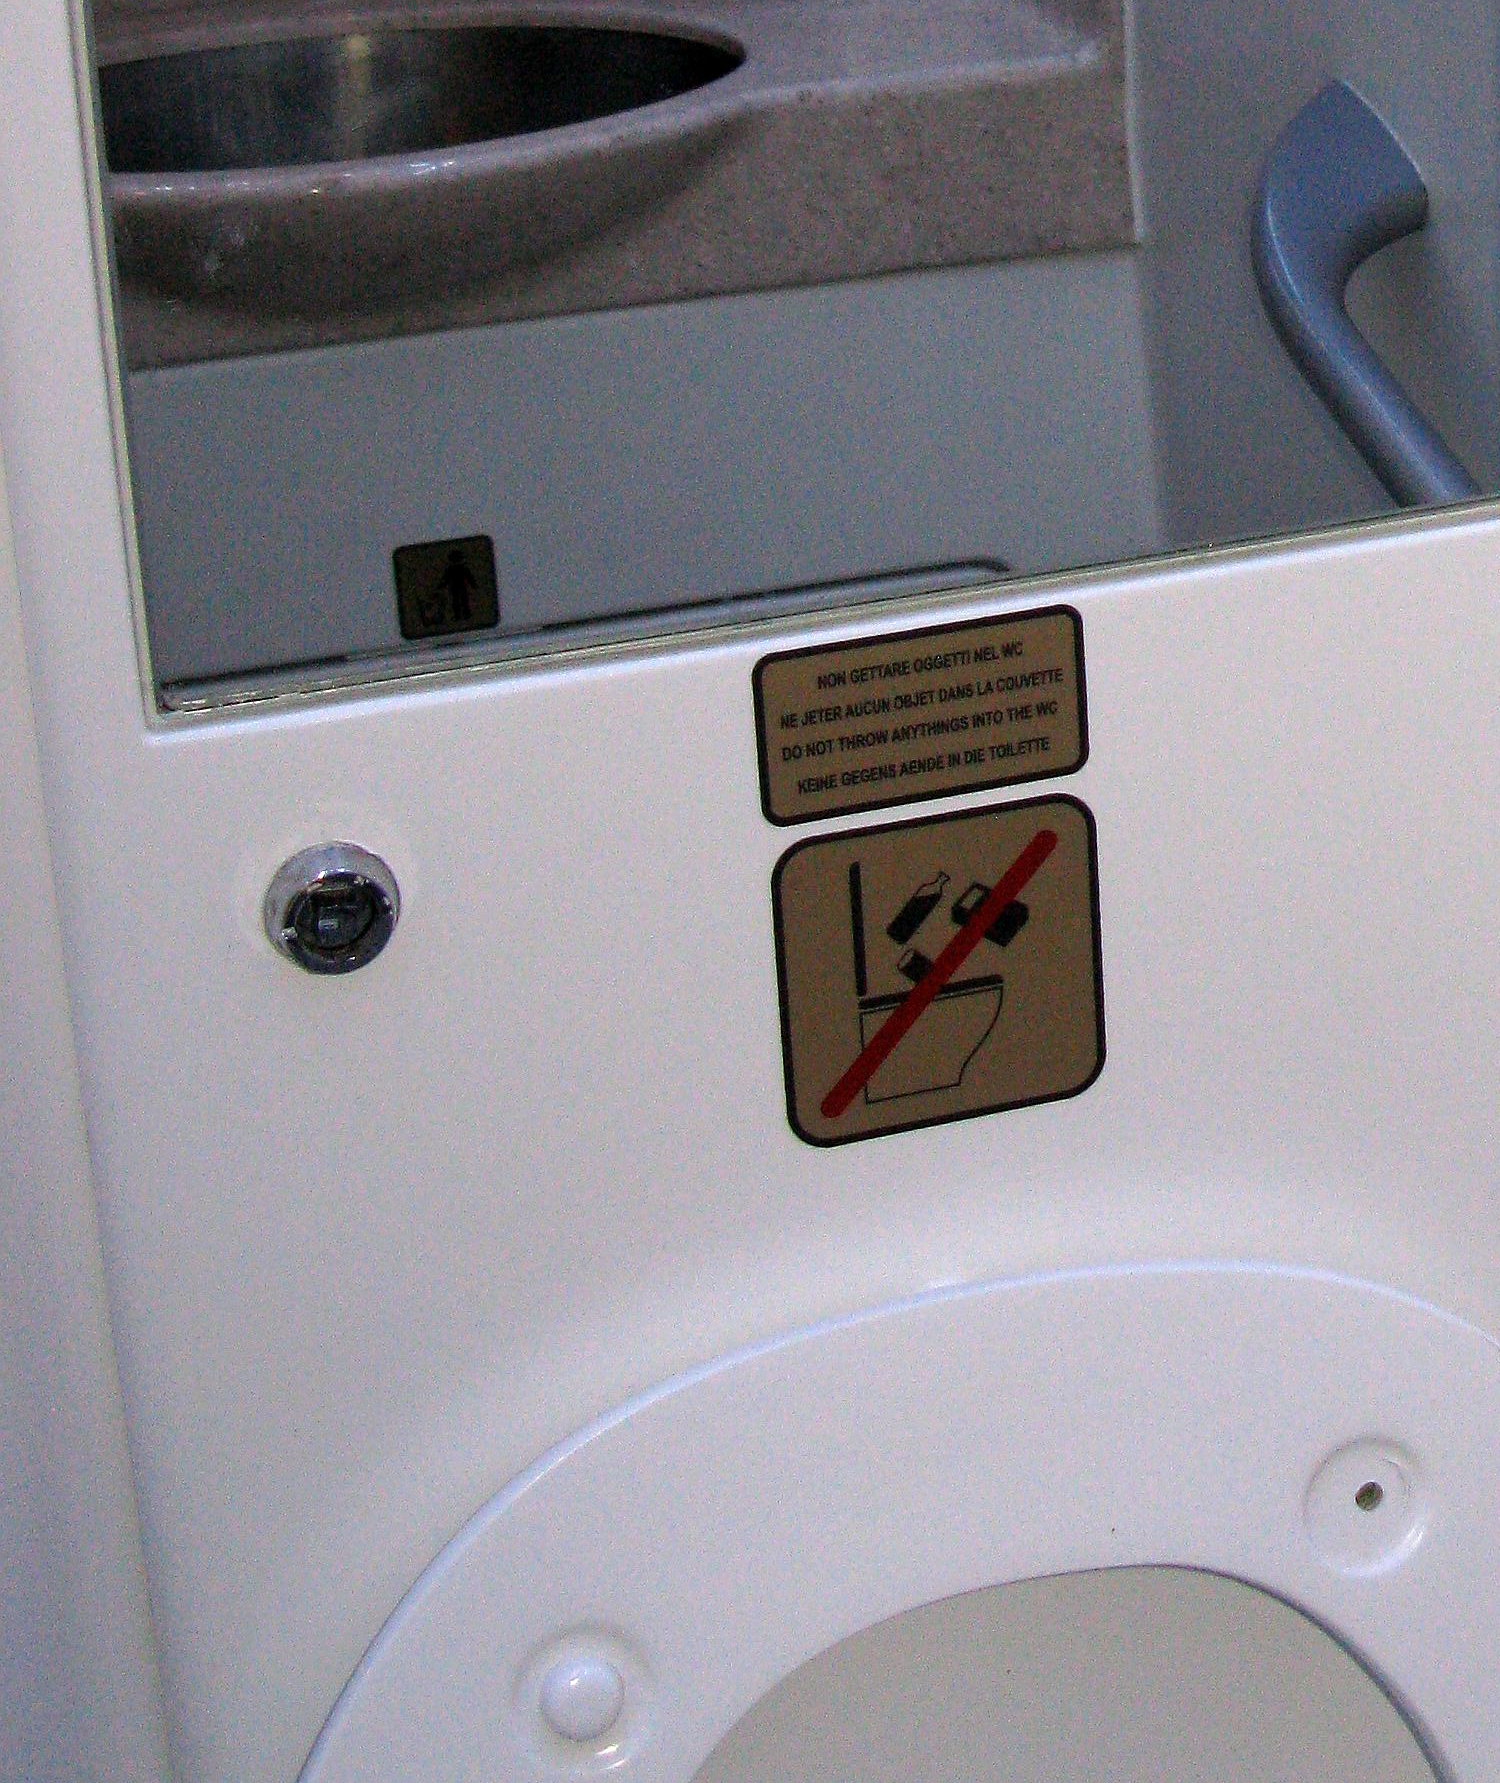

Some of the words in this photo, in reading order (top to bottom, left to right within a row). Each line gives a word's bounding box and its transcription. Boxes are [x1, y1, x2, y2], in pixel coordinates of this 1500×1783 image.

[817, 671, 847, 690] NON
[850, 661, 910, 683] GETTARE
[913, 648, 971, 673] OGGETTI
[973, 647, 999, 663] NEL
[1001, 640, 1023, 657] WC
[780, 713, 798, 729] NE
[801, 706, 842, 726] JETER
[845, 698, 890, 719] AUCUN
[894, 689, 935, 711] OBJET
[938, 683, 974, 703] DANS
[976, 681, 993, 696] LA
[996, 668, 1064, 692] COUVETTE
[782, 745, 802, 761] DO
[805, 739, 833, 757] NOT
[836, 730, 889, 751] THROW
[890, 716, 969, 743] ANYTHINGS
[972, 709, 1004, 728] INTO
[1007, 705, 1033, 721] THE
[1036, 701, 1058, 716] WC
[798, 774, 837, 793] KEINE
[841, 764, 896, 786] GEGENS
[948, 753, 960, 767] IN
[964, 748, 985, 764] DIE
[988, 736, 1050, 760] TOILETTE
